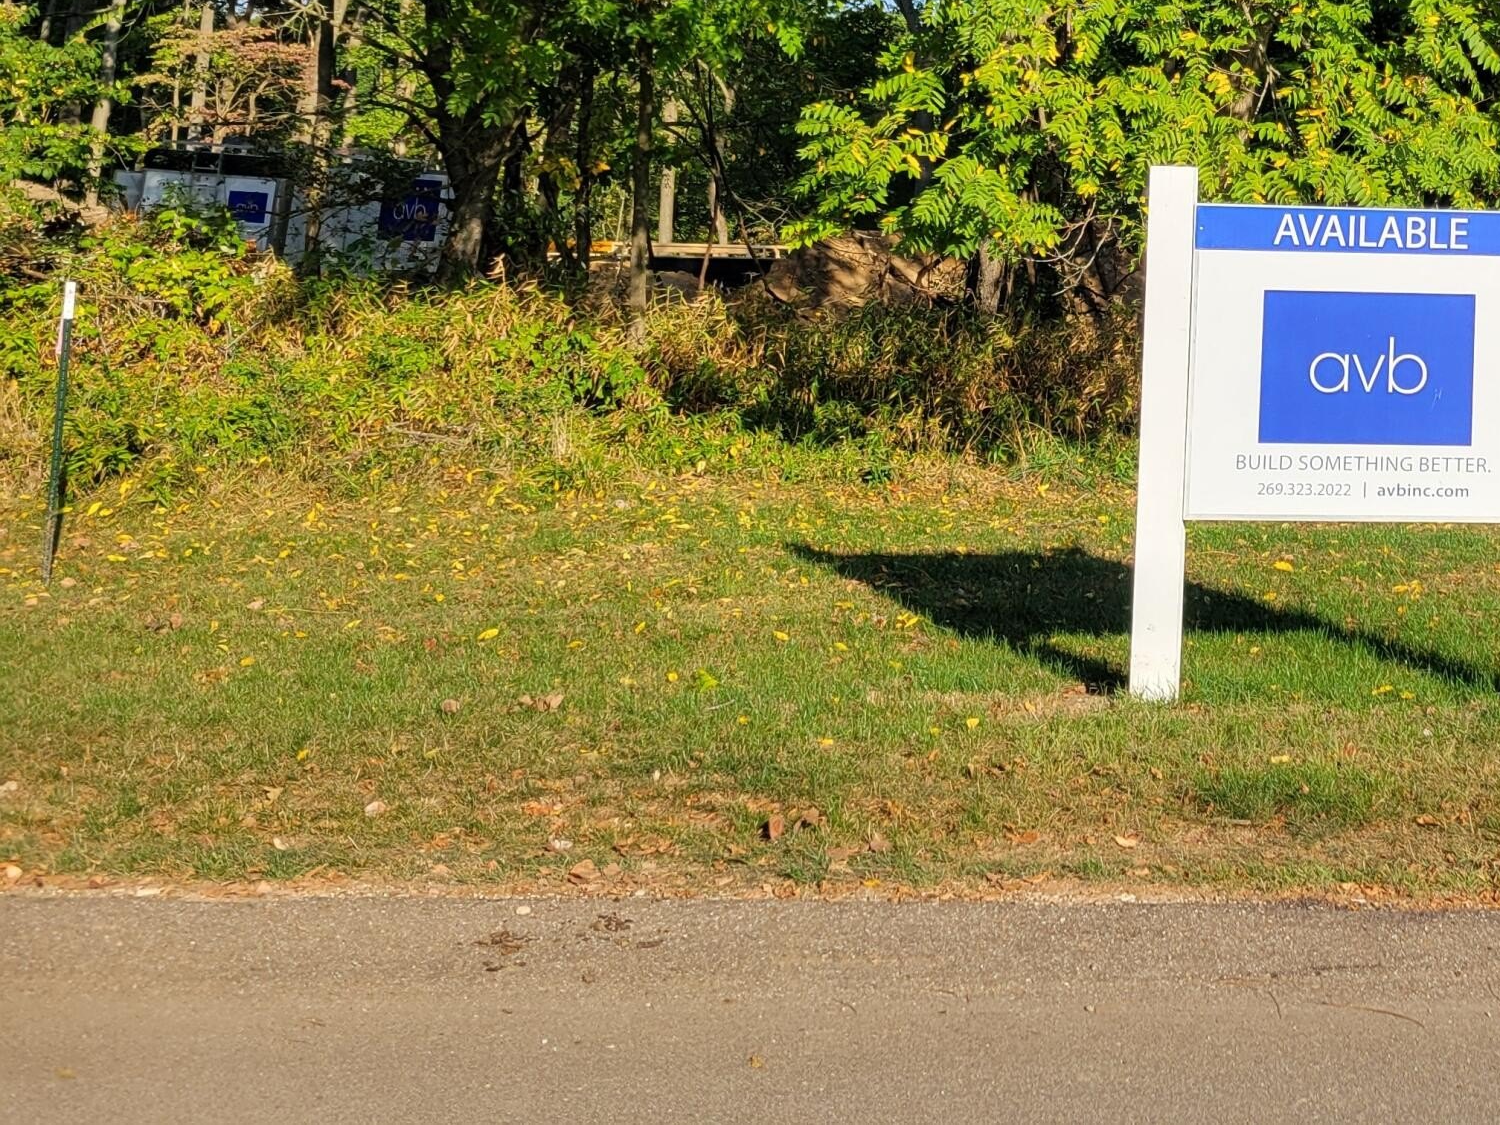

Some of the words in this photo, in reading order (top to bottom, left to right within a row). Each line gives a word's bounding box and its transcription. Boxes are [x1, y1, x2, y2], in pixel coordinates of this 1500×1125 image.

[1273, 213, 1469, 250] AVAILABLE
[1308, 336, 1428, 395] avb
[1235, 454, 1293, 470] BUILD
[1298, 455, 1413, 472] SOMETHING
[1418, 457, 1492, 473] BETTER.
[1257, 482, 1352, 496] 269.323.2022
[1376, 483, 1470, 498] avbinc.com
